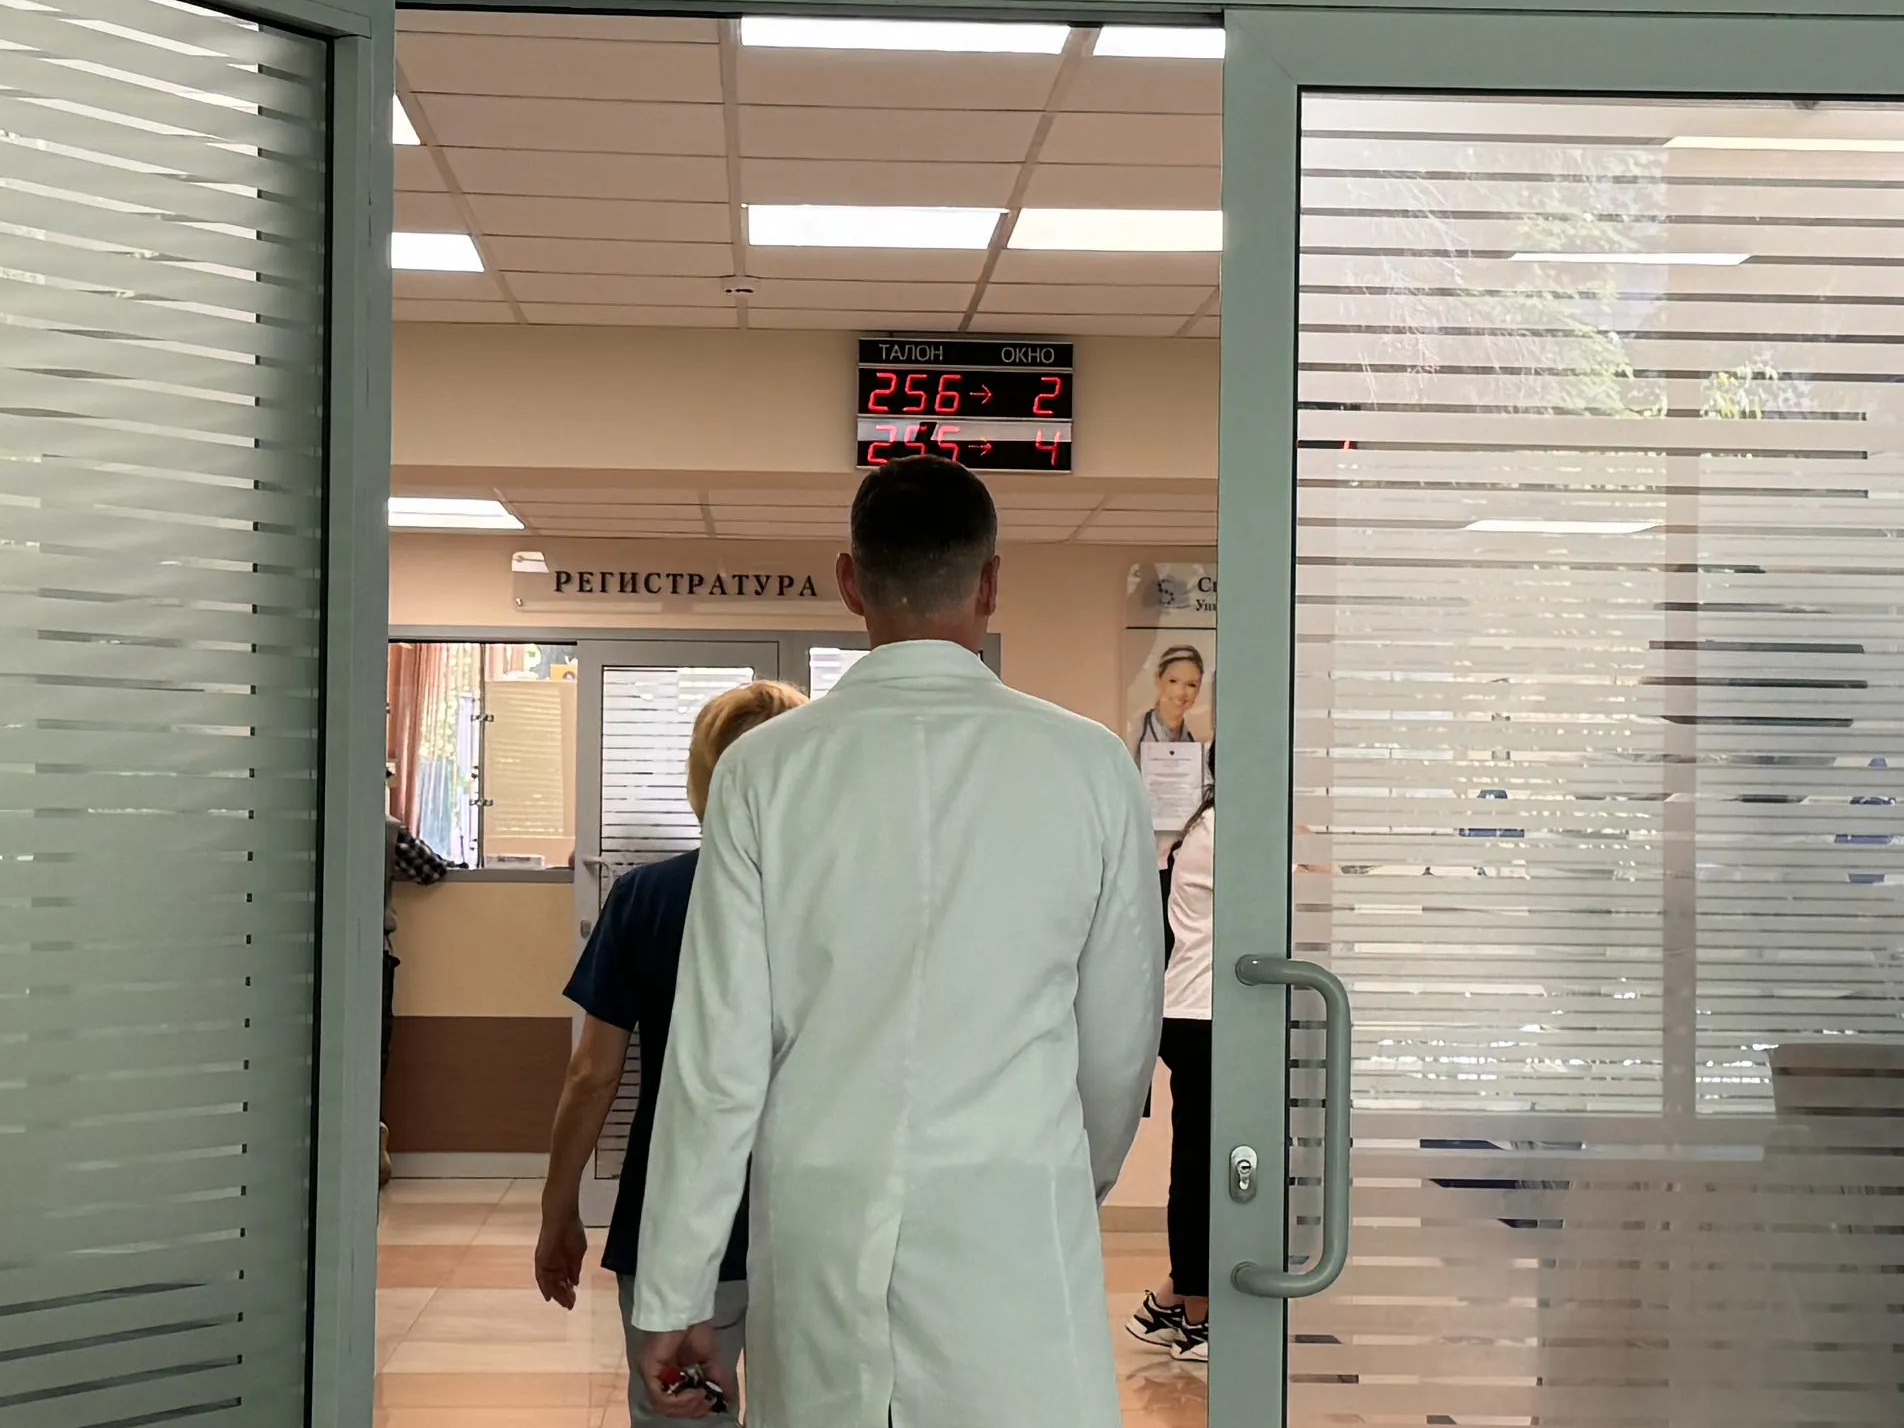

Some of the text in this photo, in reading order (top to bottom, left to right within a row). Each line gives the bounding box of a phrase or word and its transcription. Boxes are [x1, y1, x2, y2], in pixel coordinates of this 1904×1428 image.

[879, 343, 1055, 364] ТАЛОН ОКНО
[868, 372, 1063, 415] 256 2
[1035, 429, 1062, 467] 4
[554, 570, 818, 598] РЕГИСТРАТУРА
